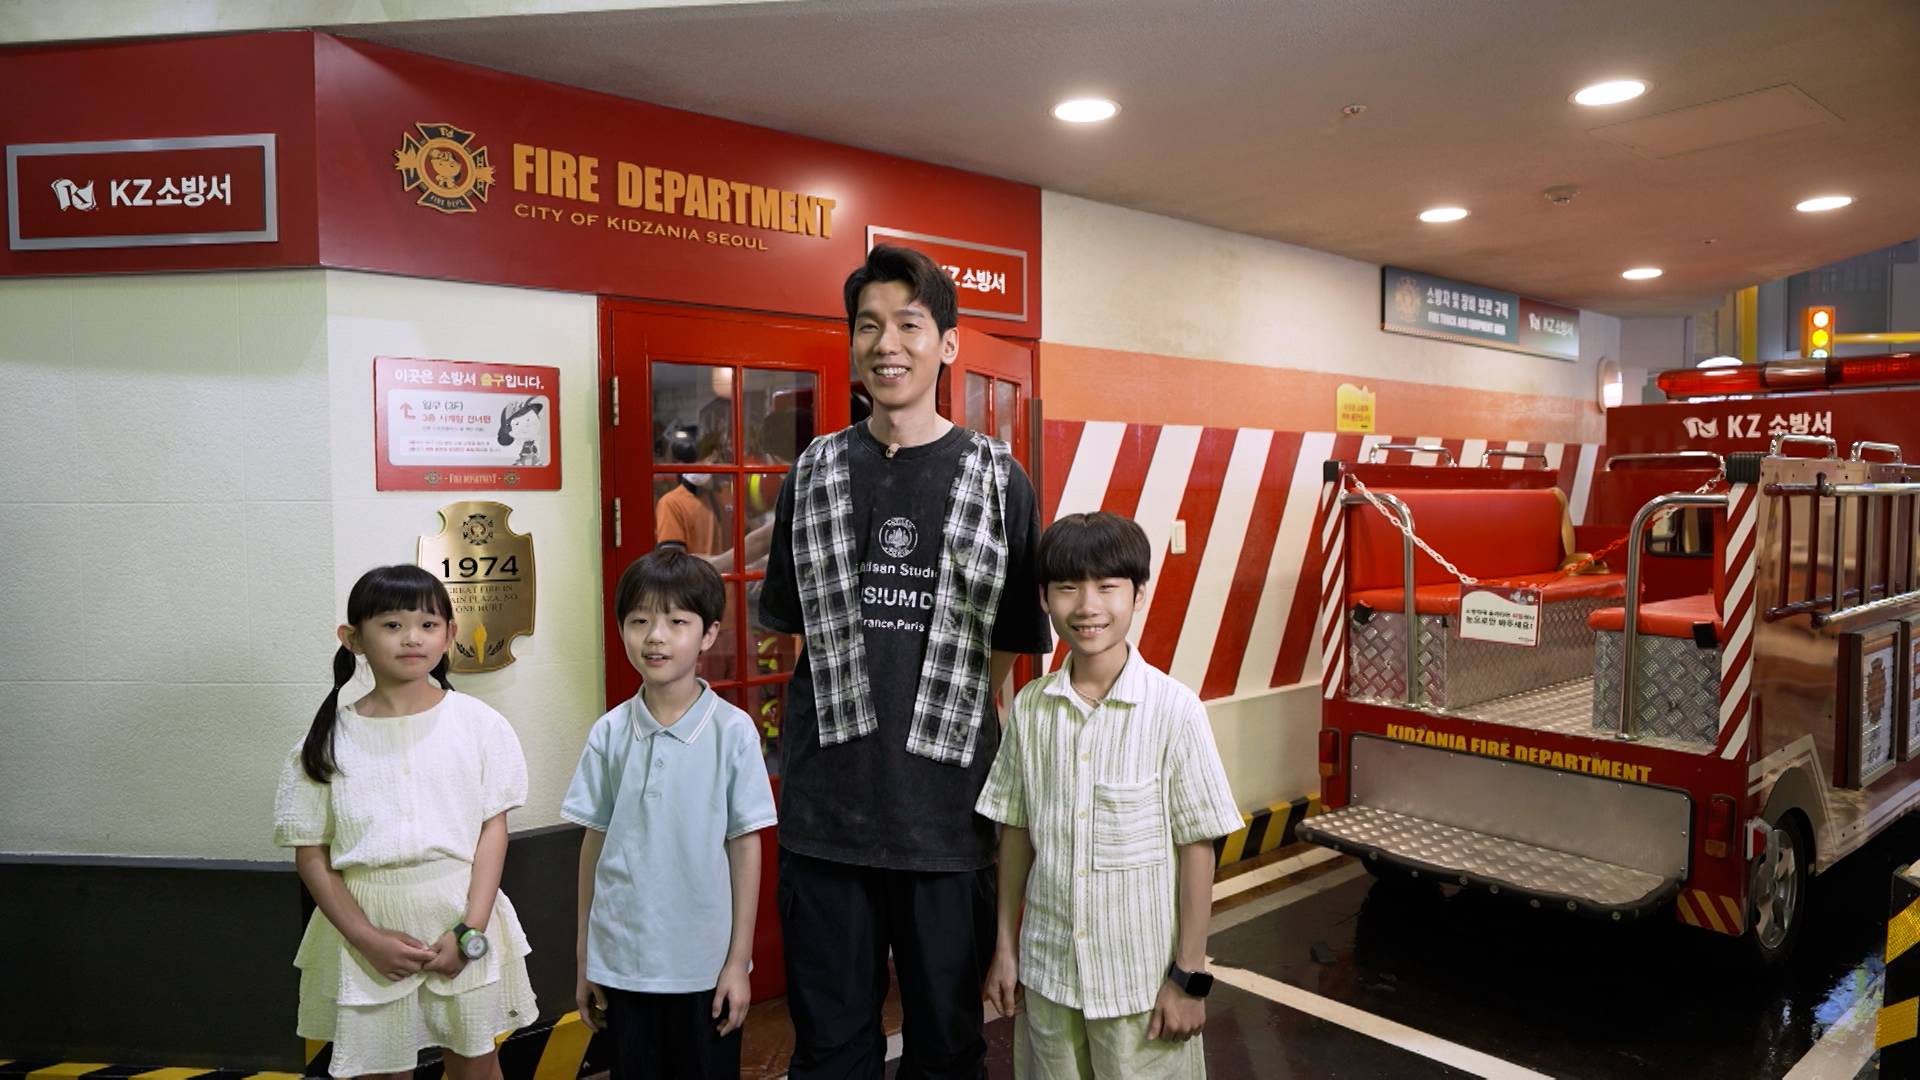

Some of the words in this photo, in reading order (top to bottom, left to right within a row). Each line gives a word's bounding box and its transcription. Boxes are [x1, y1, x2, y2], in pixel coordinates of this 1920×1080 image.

[513, 143, 599, 203] FIRE
[617, 161, 836, 239] DEPARTMENT
[514, 203, 563, 223] CITY
[570, 212, 599, 227] OF
[607, 216, 700, 241] KIDZANIA
[706, 231, 769, 251] SEOUL
[939, 265, 1006, 295] Z소방서
[394, 368, 434, 385] 이곳은
[438, 371, 476, 386] 소방서
[441, 556, 519, 578] 1974
[450, 595, 466, 604] AIN
[1386, 723, 1467, 751] KIDZANIA
[1471, 737, 1511, 759] FIRE
[1514, 745, 1652, 783] DEPARTMENT
